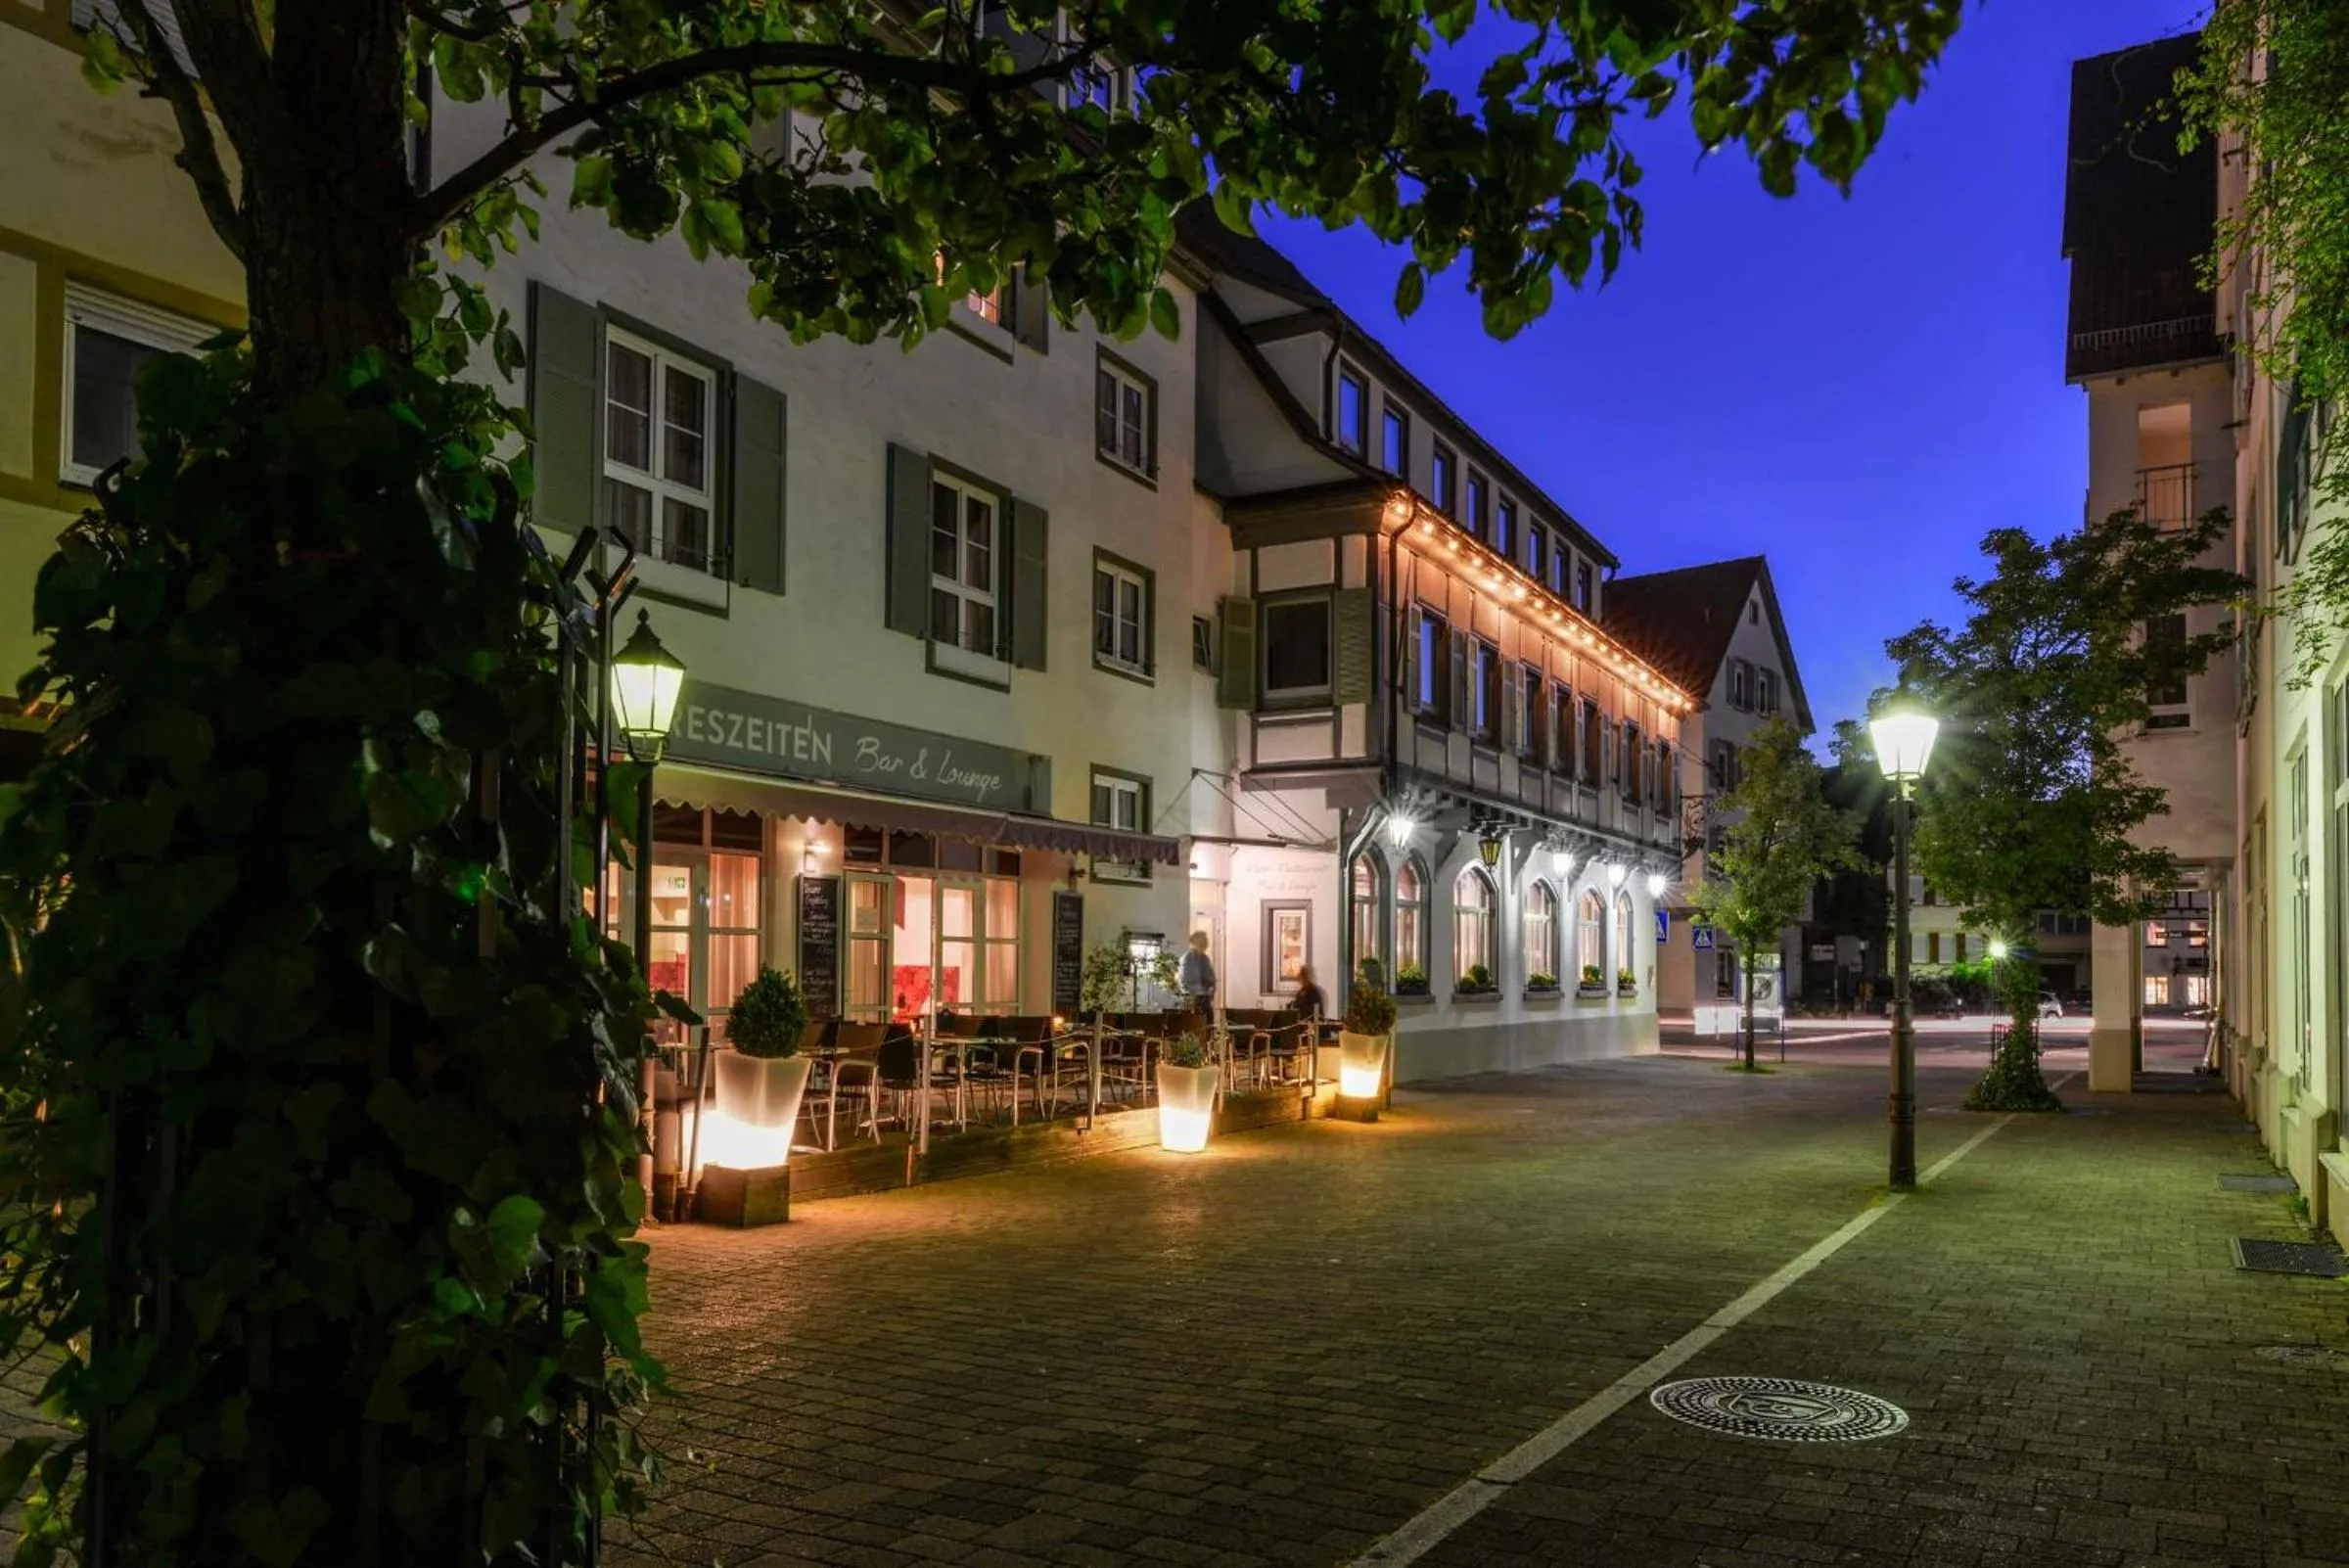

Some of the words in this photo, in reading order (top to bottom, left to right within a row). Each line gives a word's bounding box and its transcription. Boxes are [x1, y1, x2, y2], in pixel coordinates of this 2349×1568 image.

[854, 736, 904, 772] Bar
[909, 747, 929, 779] &
[936, 749, 1002, 803] Lounge
